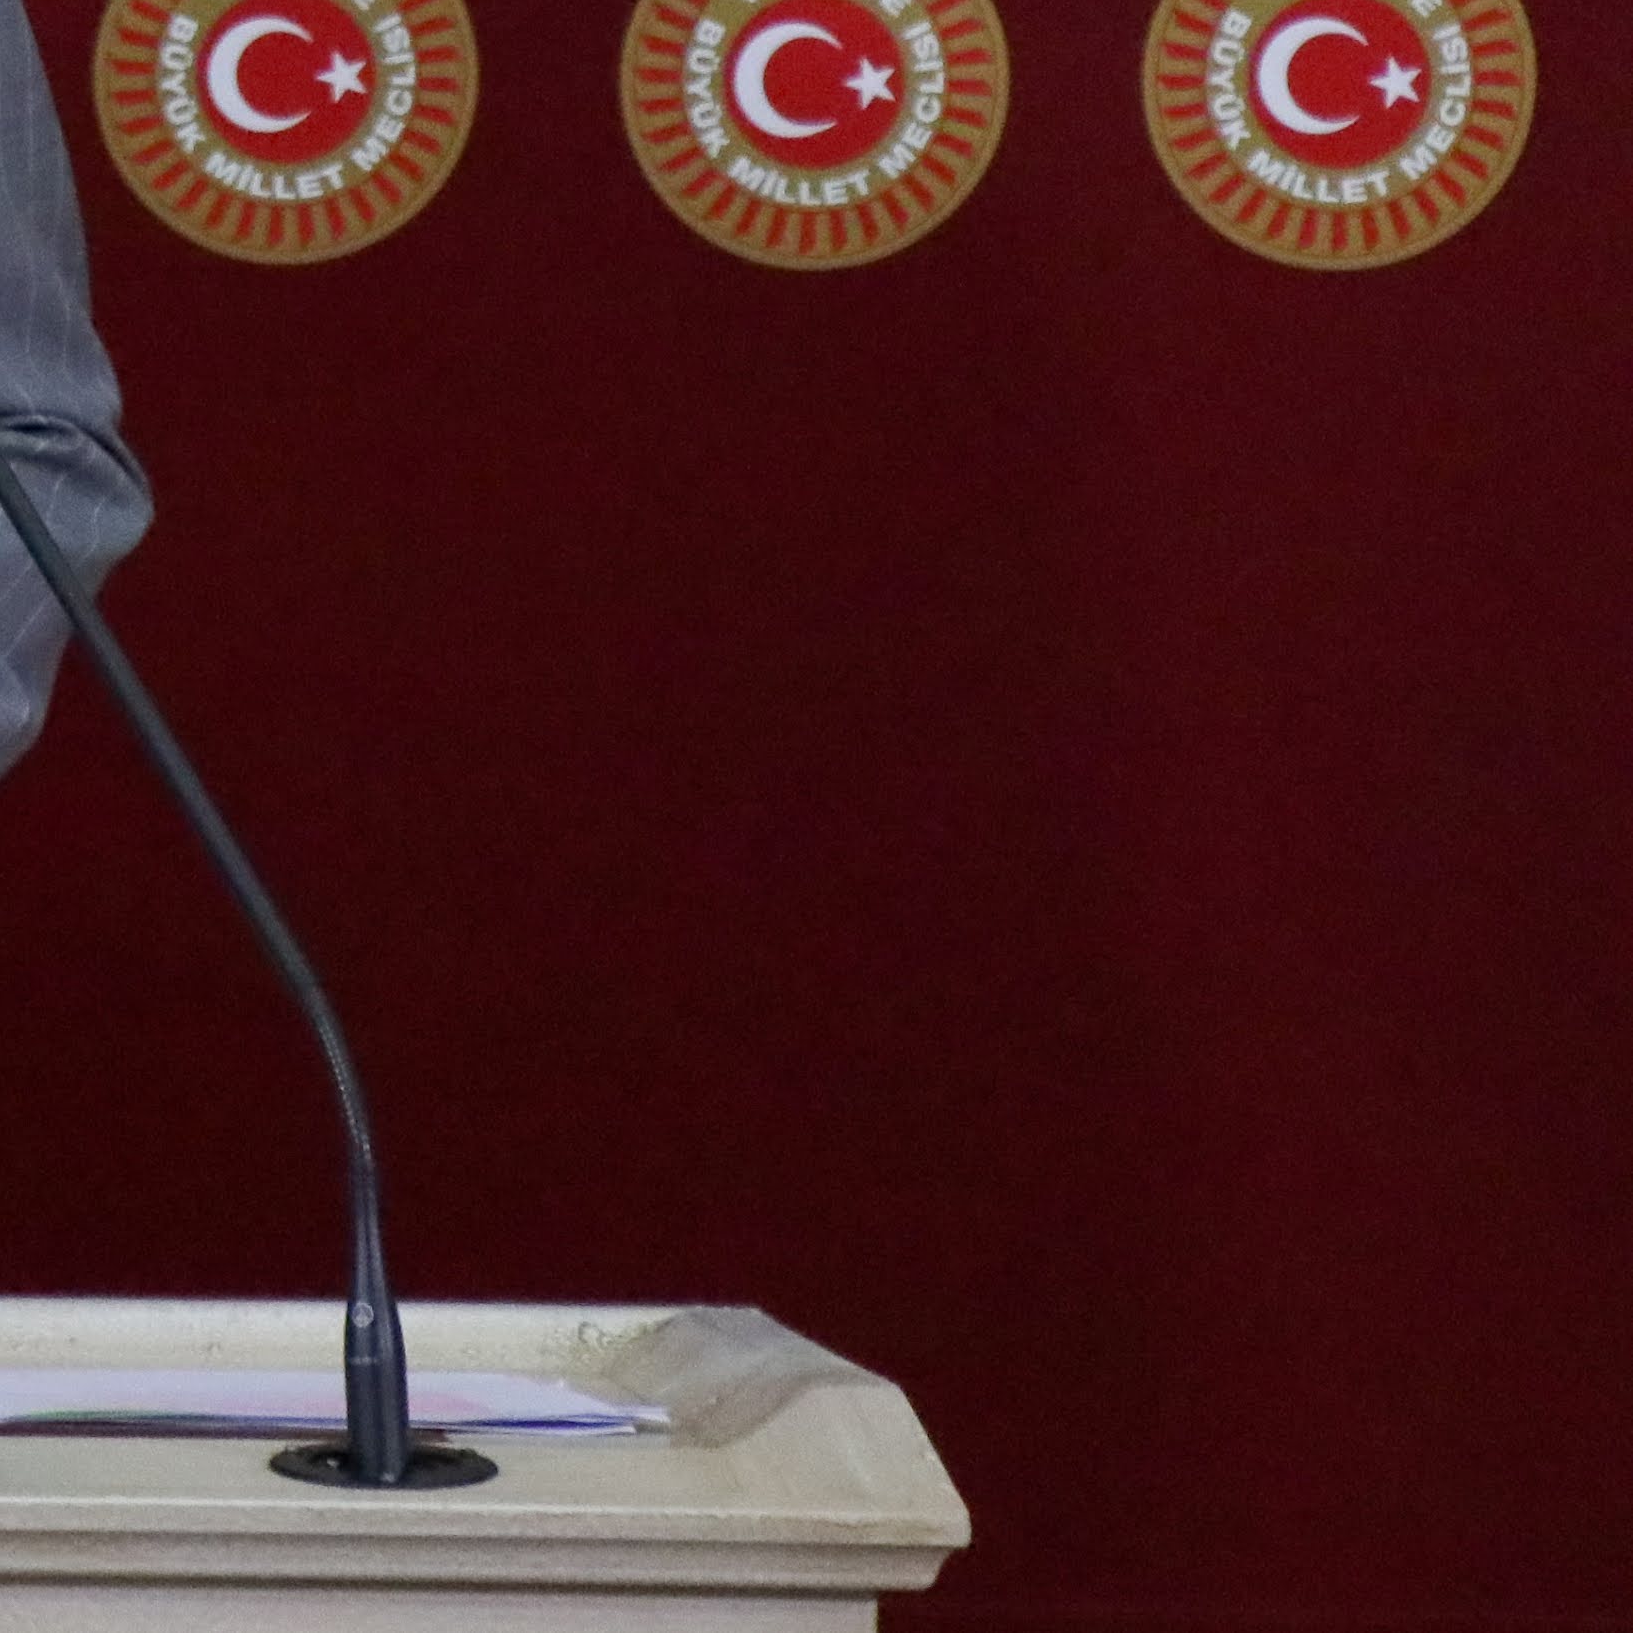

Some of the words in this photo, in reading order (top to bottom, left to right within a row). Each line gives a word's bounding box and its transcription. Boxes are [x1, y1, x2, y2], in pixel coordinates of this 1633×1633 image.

[159, 15, 206, 154] BÜYÜK
[205, 151, 345, 200] MİLLET
[685, 19, 730, 158] BÜYÜK
[727, 156, 871, 206] MİLLET
[1207, 9, 1252, 149] BÜYÜK
[1246, 149, 1390, 204] MİLLET
